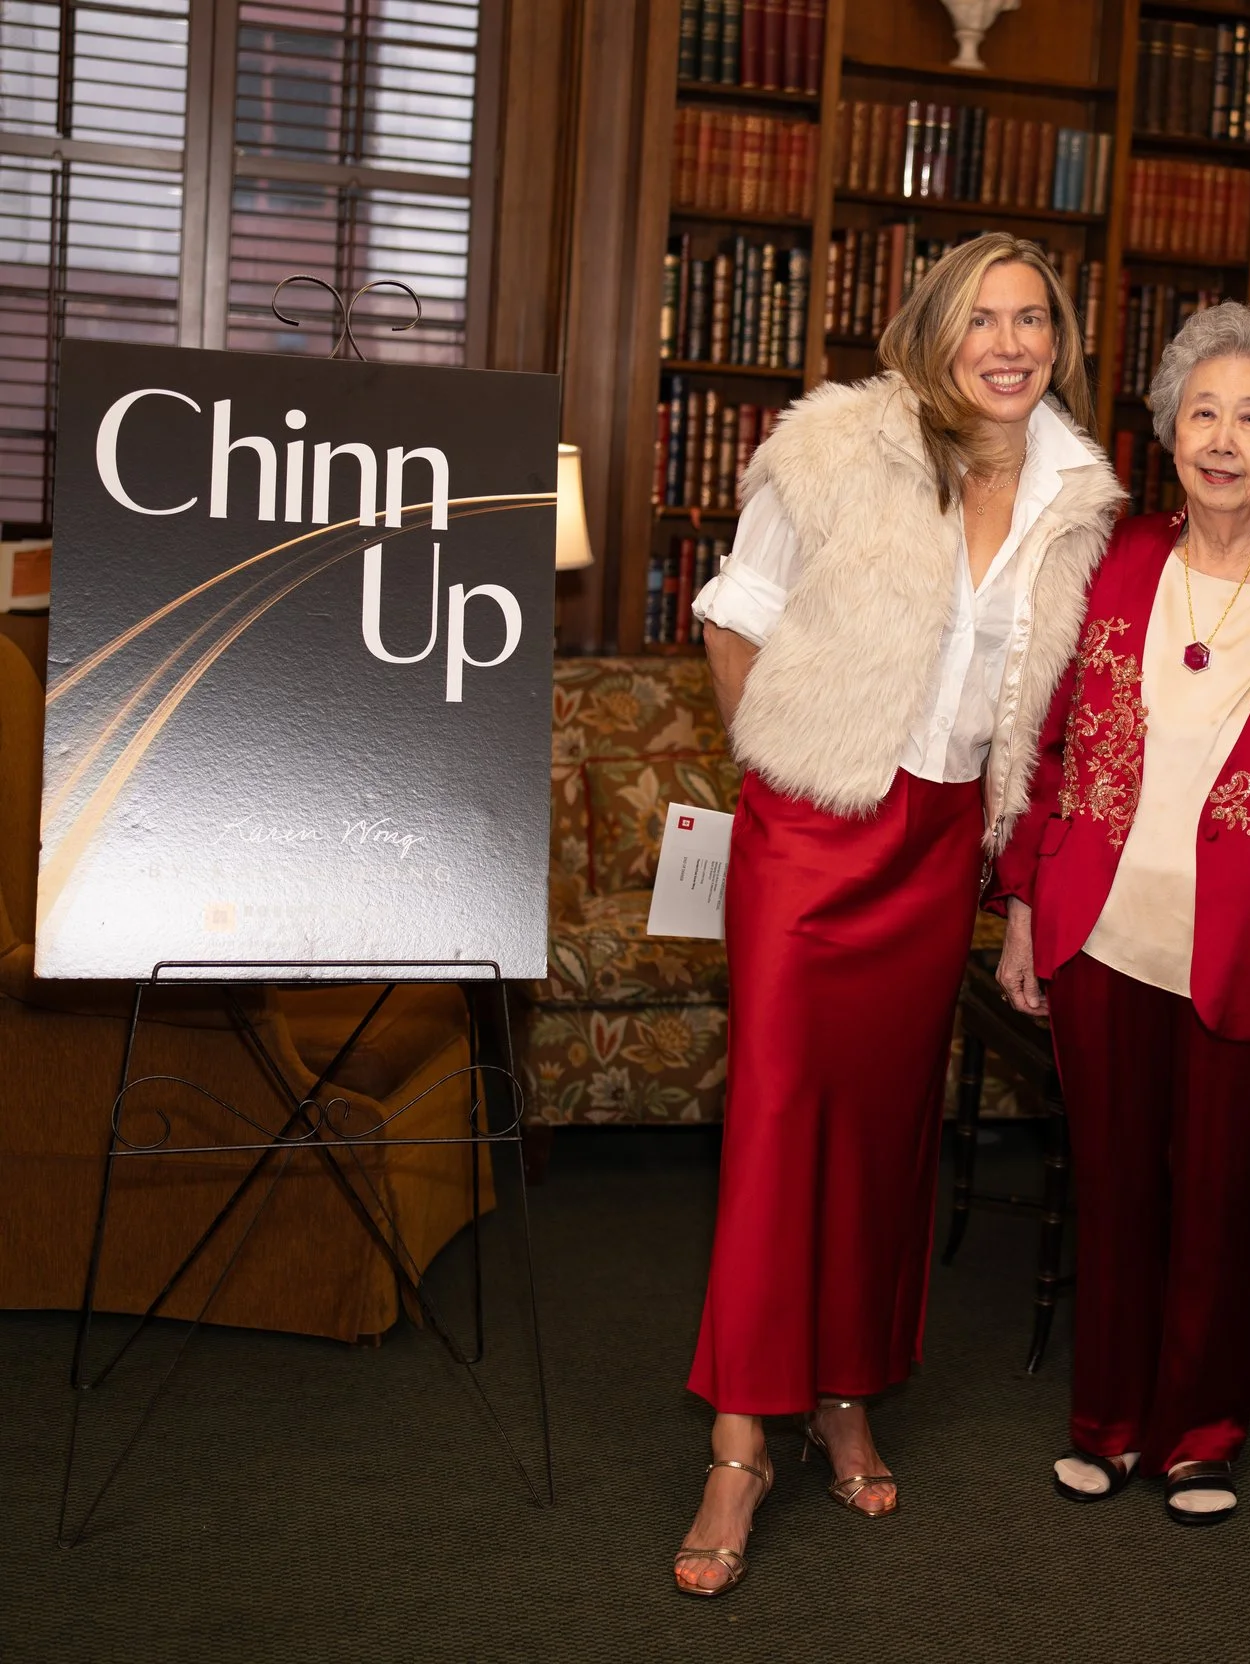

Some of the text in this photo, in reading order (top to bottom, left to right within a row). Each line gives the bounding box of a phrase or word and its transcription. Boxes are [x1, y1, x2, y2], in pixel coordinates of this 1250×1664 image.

[96, 388, 449, 530] Chinn
[362, 542, 522, 702] Up
[206, 815, 426, 859] Karen Wong
